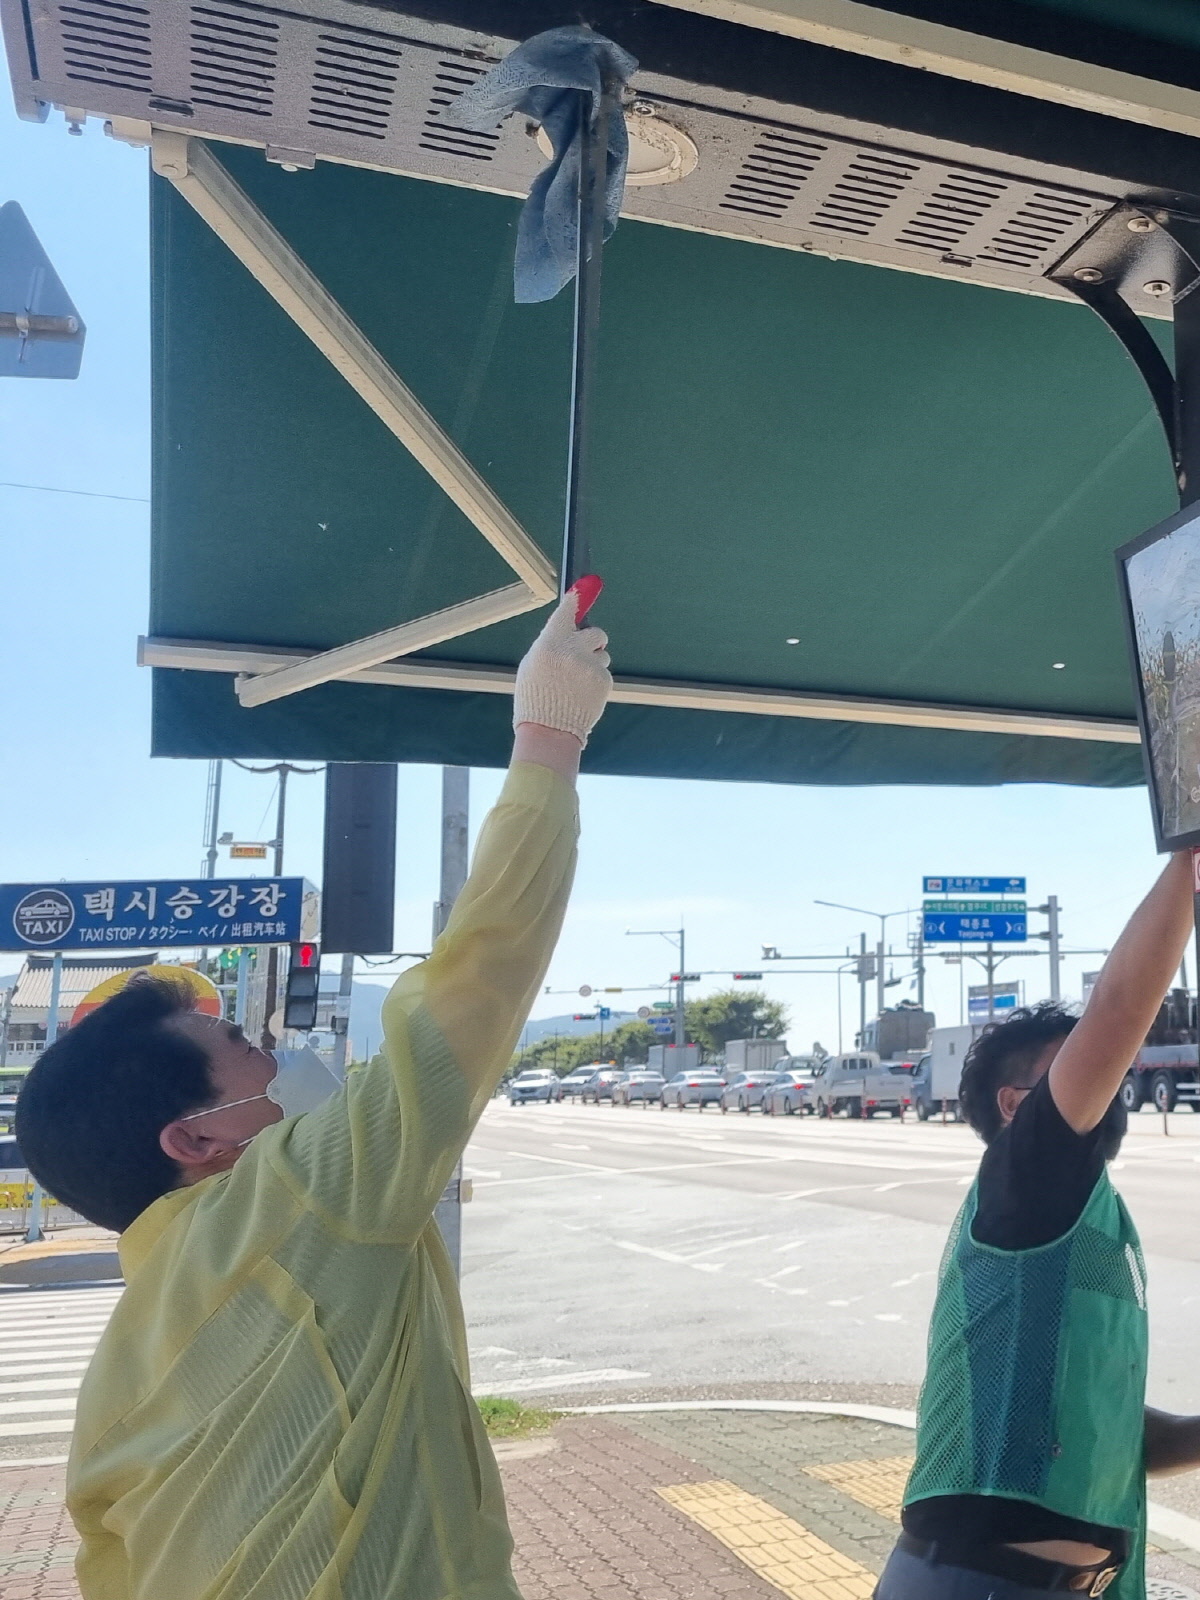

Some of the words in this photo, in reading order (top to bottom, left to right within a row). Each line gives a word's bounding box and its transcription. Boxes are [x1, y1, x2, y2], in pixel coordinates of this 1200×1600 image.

[83, 884, 286, 922] 택시승강장
[22, 920, 63, 935] TAXI
[79, 928, 106, 942] TAXI
[106, 927, 136, 941] STOP
[231, 922, 287, 938] 出租汽车站
